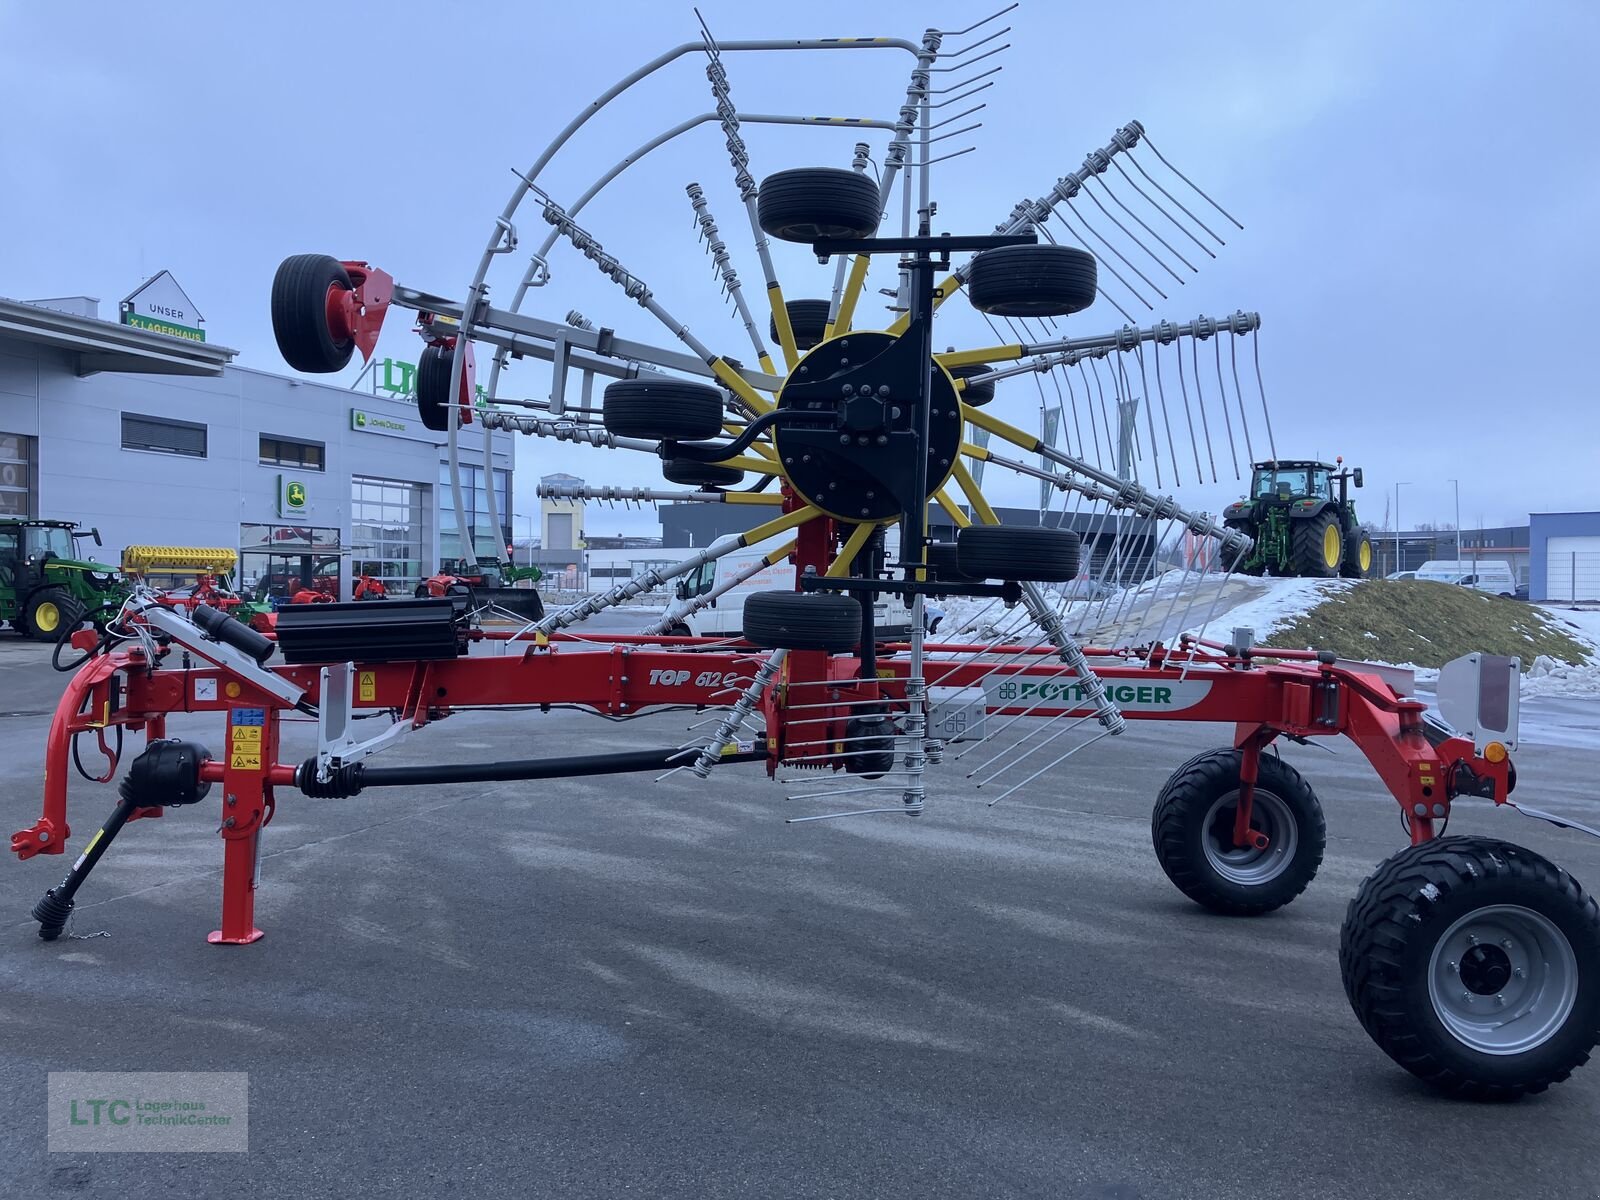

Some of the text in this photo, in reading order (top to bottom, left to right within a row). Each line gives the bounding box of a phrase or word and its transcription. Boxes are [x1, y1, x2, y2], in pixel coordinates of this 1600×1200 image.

[149, 303, 184, 320] UNSER
[140, 321, 201, 342] LAGERHAUS
[383, 357, 418, 395] LT
[649, 669, 691, 686] TOP
[1021, 683, 1172, 704] PÖTTNGER
